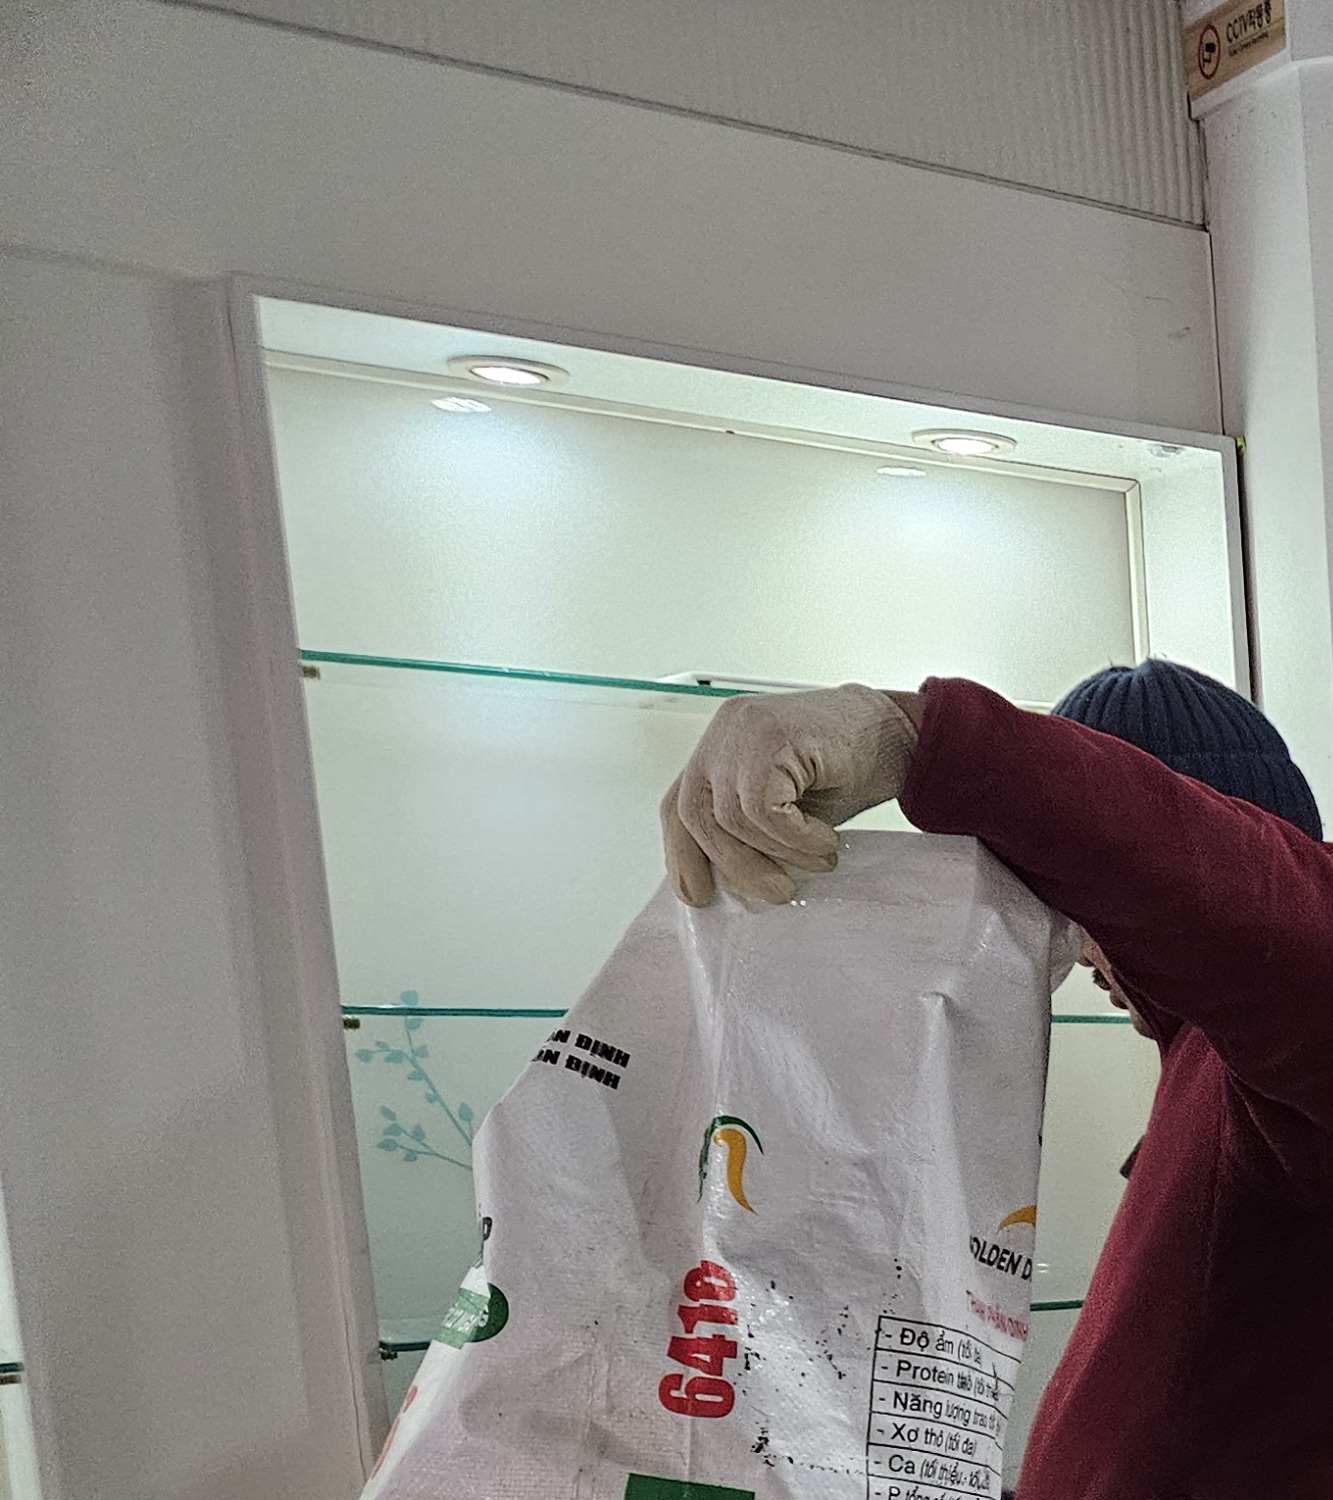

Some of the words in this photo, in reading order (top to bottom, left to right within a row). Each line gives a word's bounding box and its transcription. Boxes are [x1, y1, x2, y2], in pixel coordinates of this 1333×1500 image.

[969, 1236, 1022, 1275] OLDEN
[900, 1327, 930, 1352] Độ
[896, 1360, 954, 1386] Protein
[893, 1391, 943, 1419] Năng
[891, 1422, 919, 1442] Xơ
[888, 1454, 915, 1475] Ca
